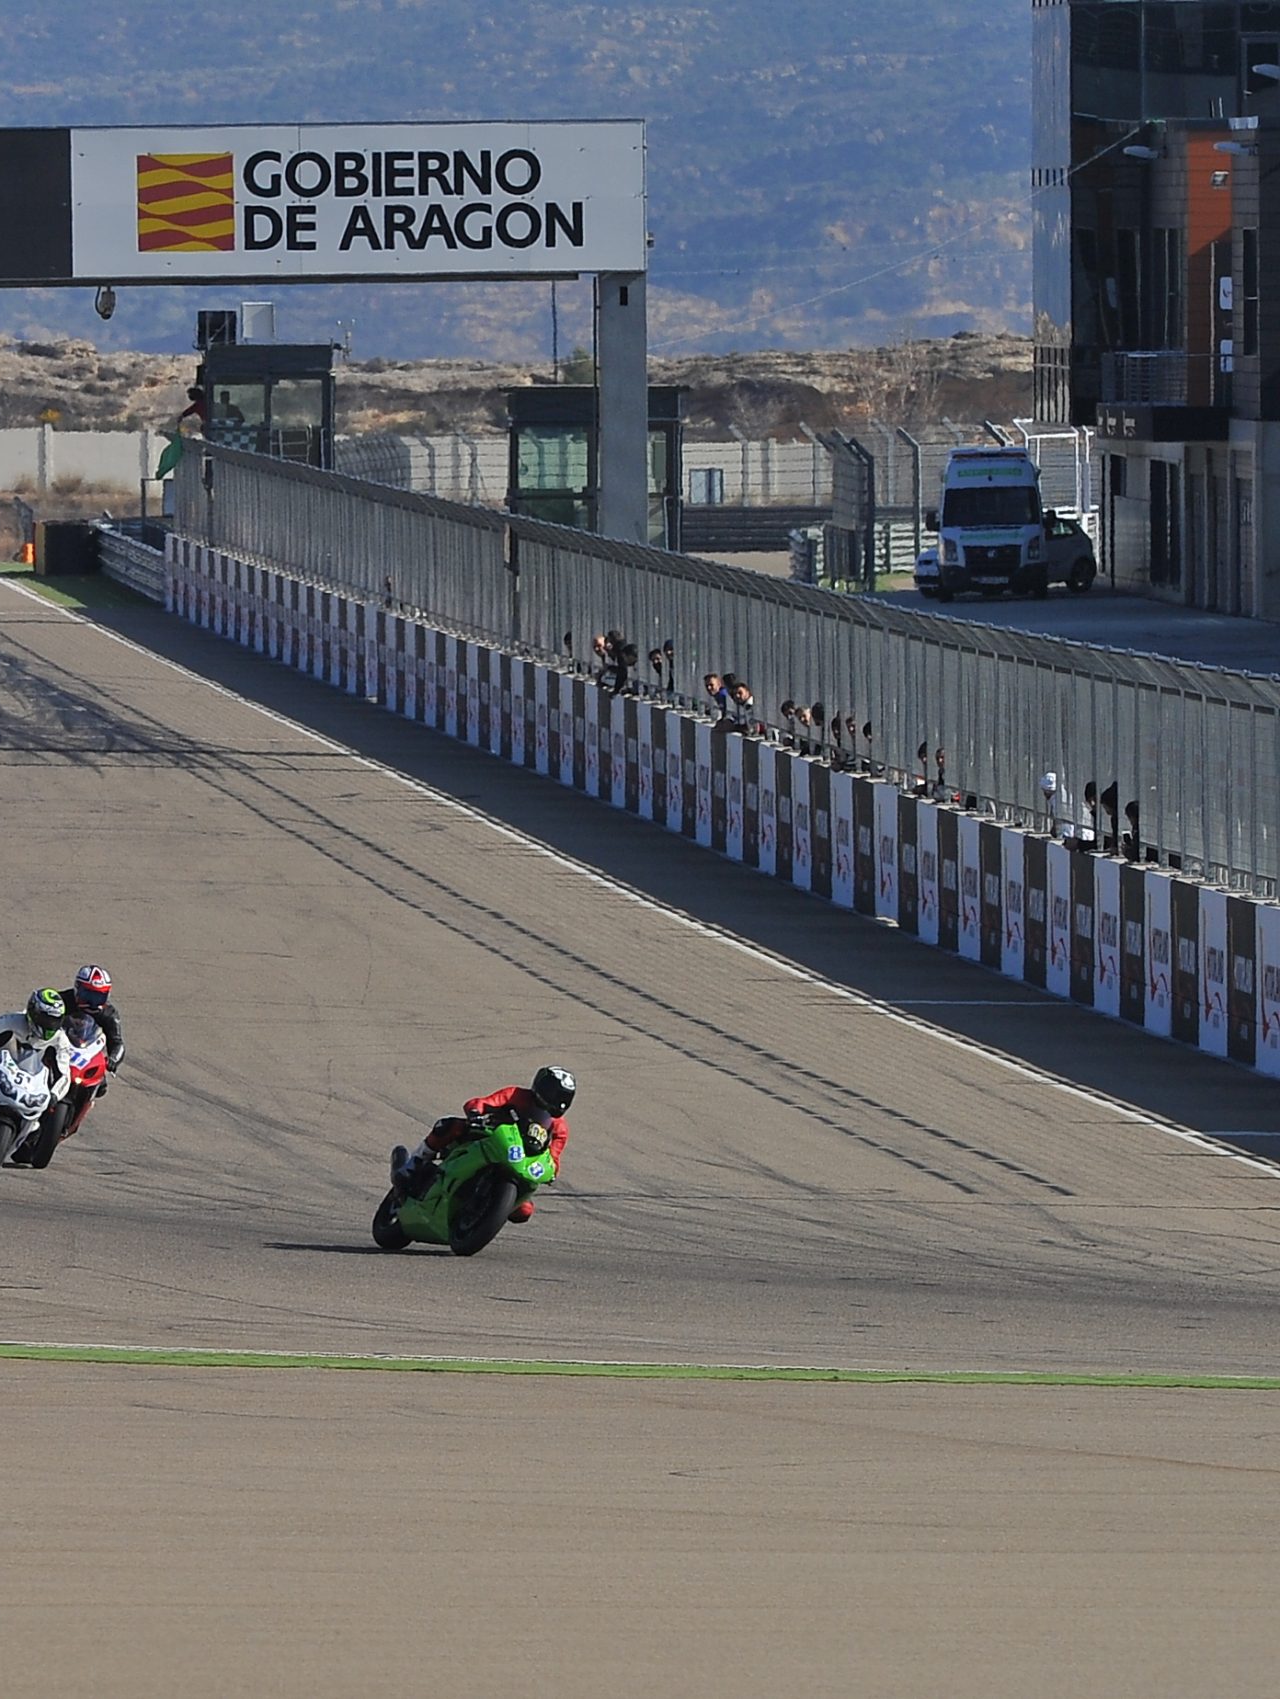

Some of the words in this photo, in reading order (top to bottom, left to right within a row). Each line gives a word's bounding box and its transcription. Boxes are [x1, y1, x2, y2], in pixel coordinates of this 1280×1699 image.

[242, 148, 542, 199] GOBIERNO
[243, 204, 317, 252] DE
[338, 201, 585, 251] ARAGON
